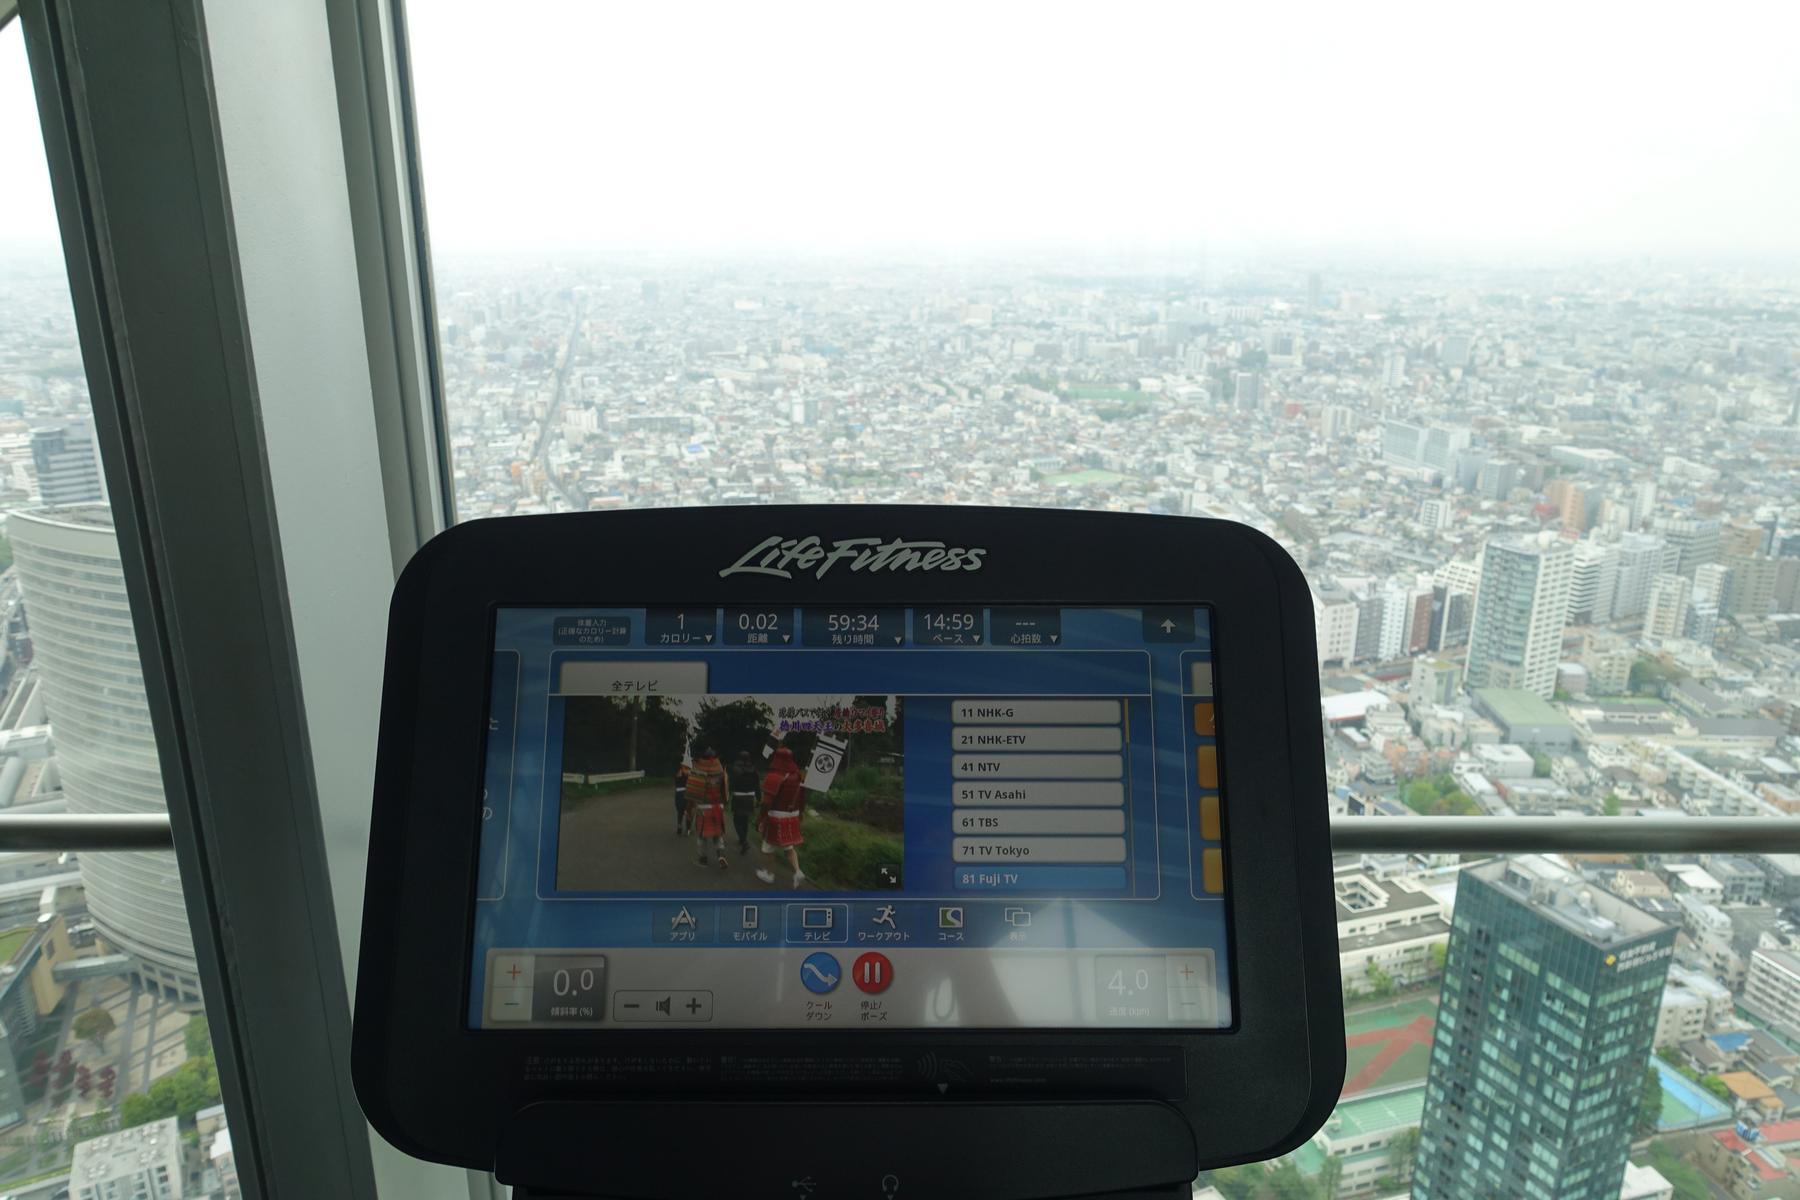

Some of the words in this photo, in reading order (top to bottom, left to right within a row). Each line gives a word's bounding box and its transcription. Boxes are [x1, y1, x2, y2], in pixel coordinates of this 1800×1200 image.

[718, 535, 824, 579] Life
[815, 537, 987, 580] Fitness
[677, 613, 684, 630] 1
[738, 613, 778, 631] 0.02
[828, 614, 880, 632] 59:34
[923, 613, 974, 631] 14:59
[660, 633, 701, 644] カロリー
[748, 633, 769, 644] 距離
[832, 634, 874, 645] 残り時間
[1010, 633, 1042, 644] 心拍数
[611, 680, 658, 692] 全テレビ
[961, 708, 973, 718] 11
[977, 708, 1014, 718] NHK-G
[961, 735, 974, 745] 21
[977, 735, 1026, 745] NHK-ETV
[961, 762, 974, 772] 41
[977, 762, 1001, 772] NTV
[962, 790, 974, 800] 51
[978, 790, 992, 800] TV
[994, 789, 1026, 800] Asahi
[962, 817, 975, 827] 61
[978, 817, 999, 827] TBS
[962, 846, 975, 856] 71
[979, 846, 993, 856] TV
[995, 845, 1030, 858] Tokyo
[962, 874, 975, 884] 81
[979, 873, 1001, 886] Fuji
[1003, 874, 1018, 884] TV
[670, 931, 695, 942] アプリ
[733, 931, 768, 942] モバイル
[804, 931, 831, 941] テレビ
[858, 931, 910, 941] ワークアウト
[938, 932, 964, 941] コース
[553, 969, 594, 996] 0.0
[1107, 969, 1149, 995] 4.0
[806, 1001, 832, 1010] クール
[806, 1012, 832, 1021] ダウン
